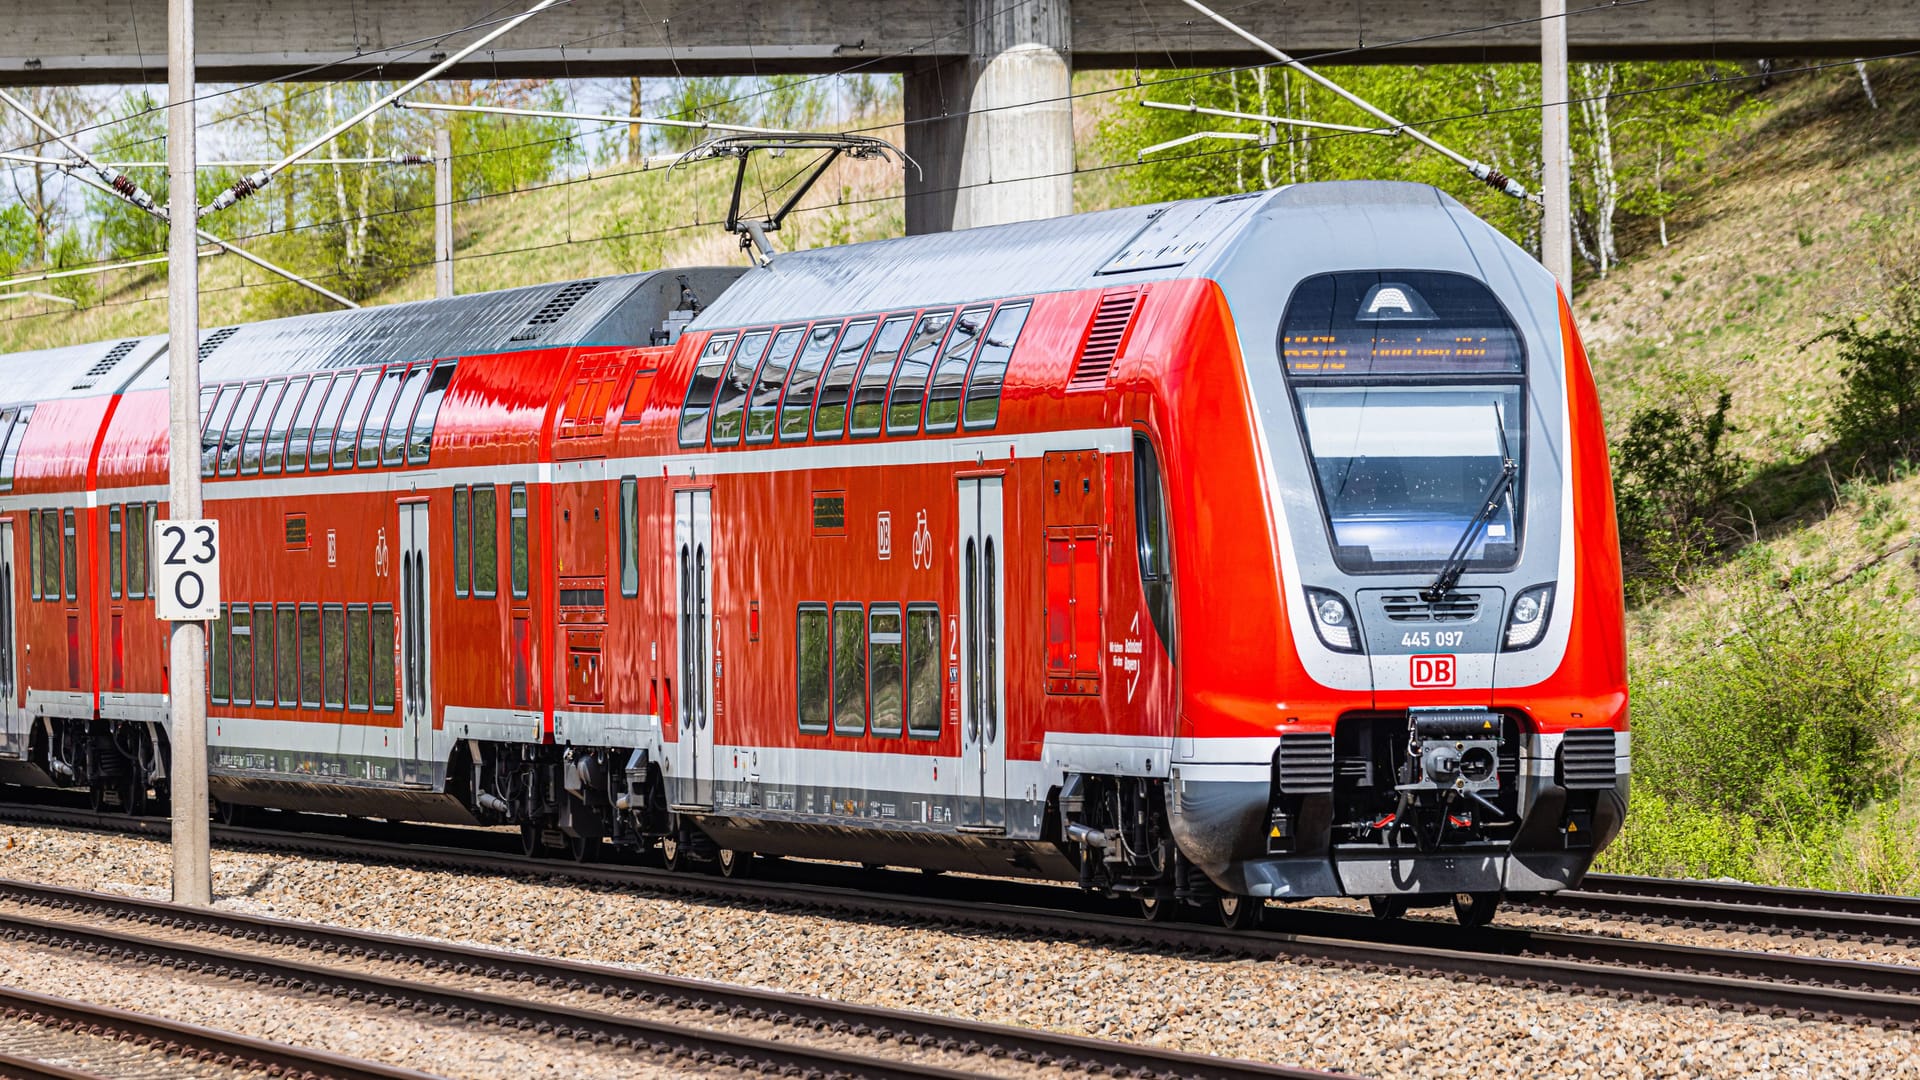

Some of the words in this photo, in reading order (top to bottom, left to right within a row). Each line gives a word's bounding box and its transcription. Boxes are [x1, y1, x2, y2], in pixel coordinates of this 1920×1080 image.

[162, 525, 216, 565] 23
[879, 518, 890, 552] DB
[175, 570, 204, 609] 0
[395, 616, 400, 650] 2
[716, 619, 721, 656] 2
[950, 619, 957, 661] 2
[1401, 632, 1430, 647] 445
[1435, 631, 1463, 646] 097
[1415, 659, 1451, 683] DB
